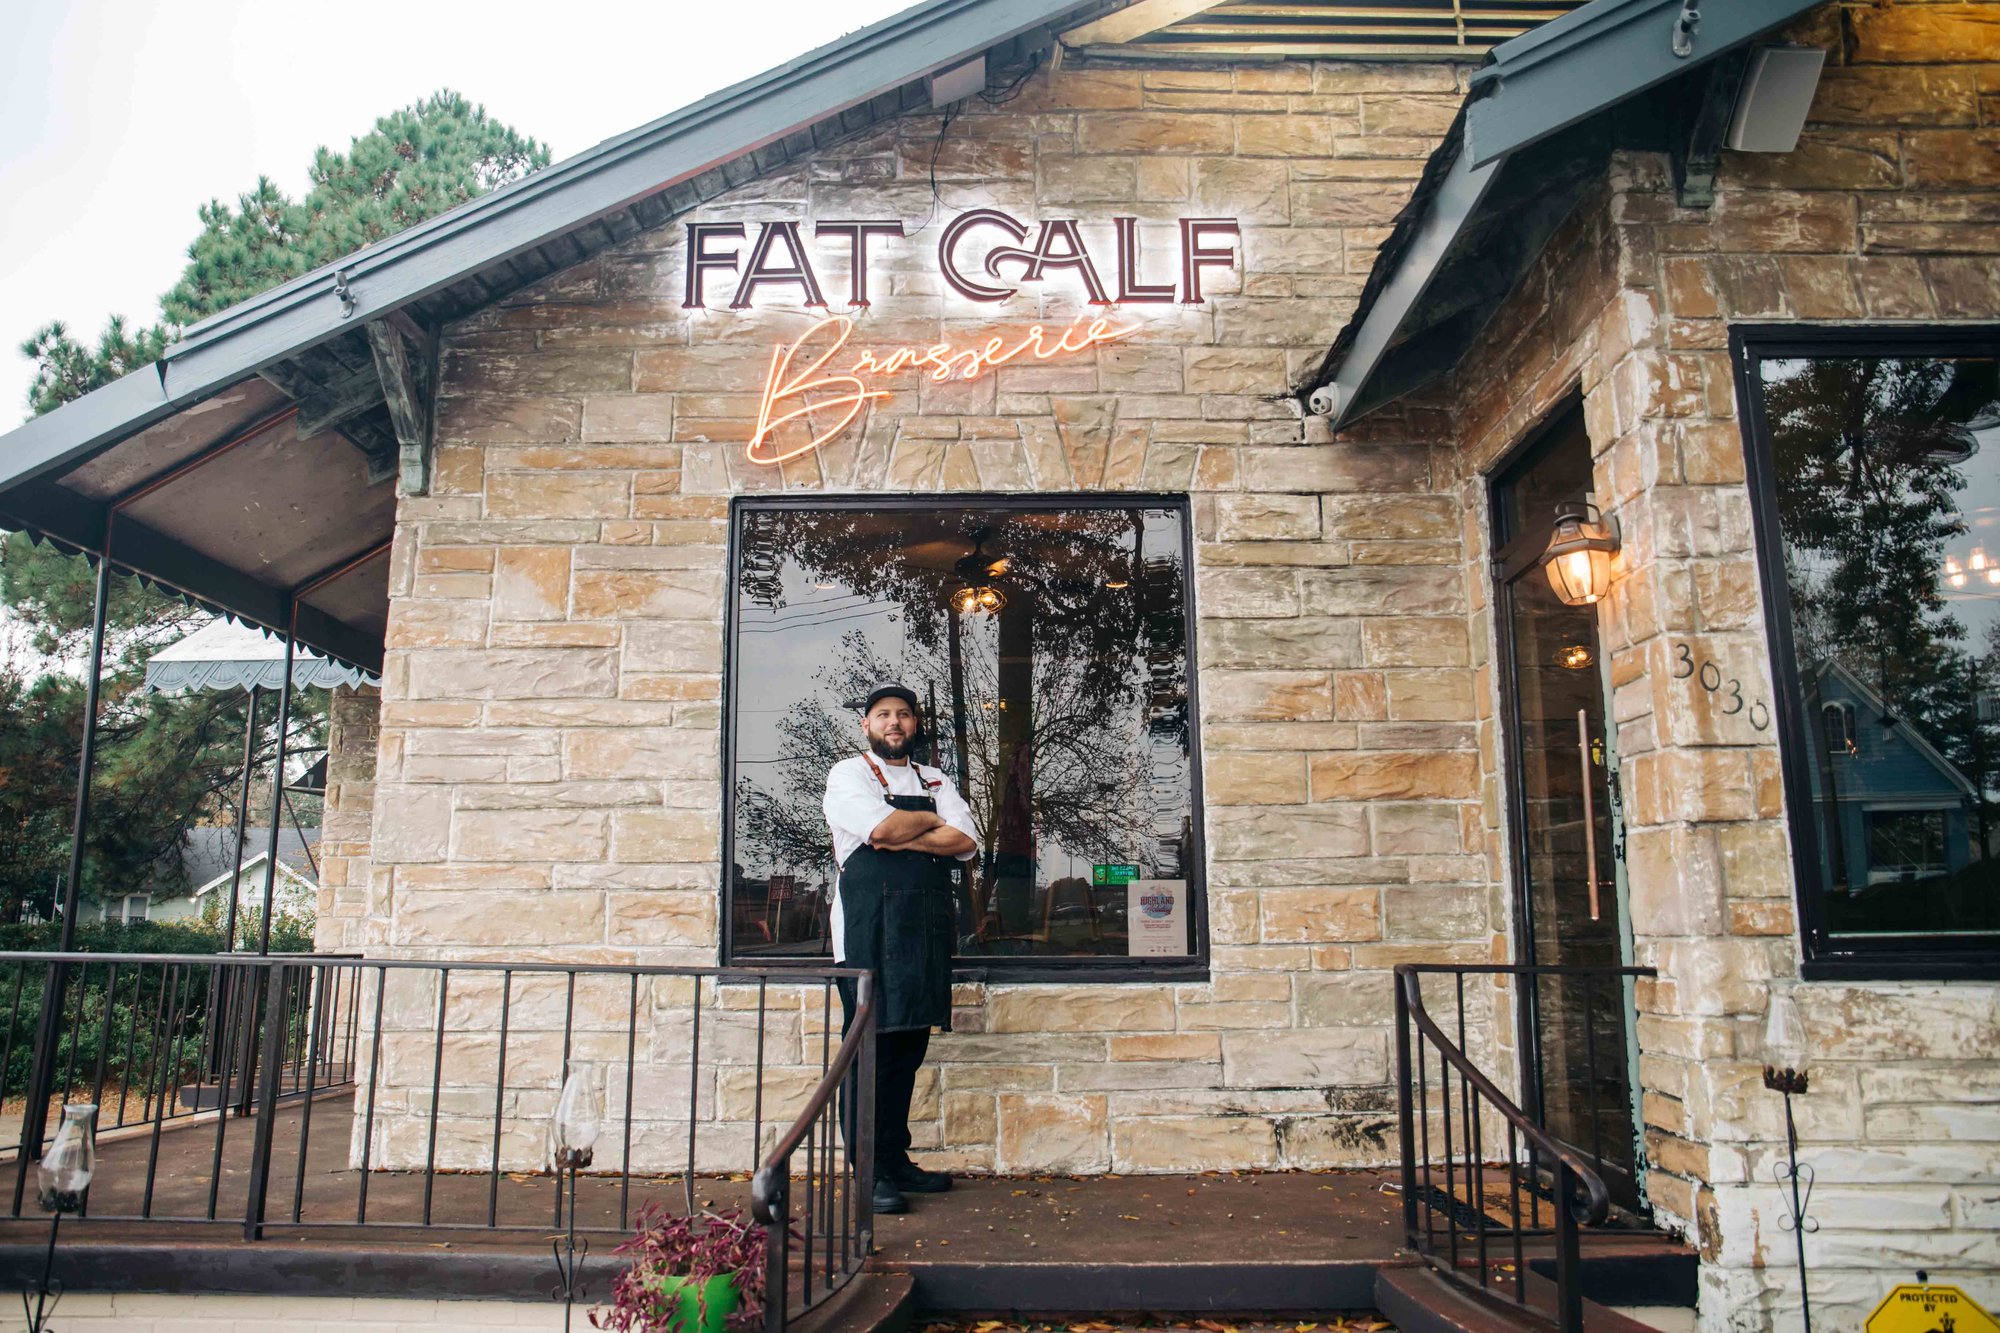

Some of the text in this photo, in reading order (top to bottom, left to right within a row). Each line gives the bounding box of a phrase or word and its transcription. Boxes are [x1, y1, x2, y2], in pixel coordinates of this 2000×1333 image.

[681, 208, 1239, 309] FAT CALF
[746, 314, 1143, 466] Brasserie
[1673, 643, 1770, 732] 3030
[1140, 896, 1175, 905] HIGHLAND
[1899, 1293, 1958, 1304] PROTECTED
[1924, 1303, 1936, 1312] BY
